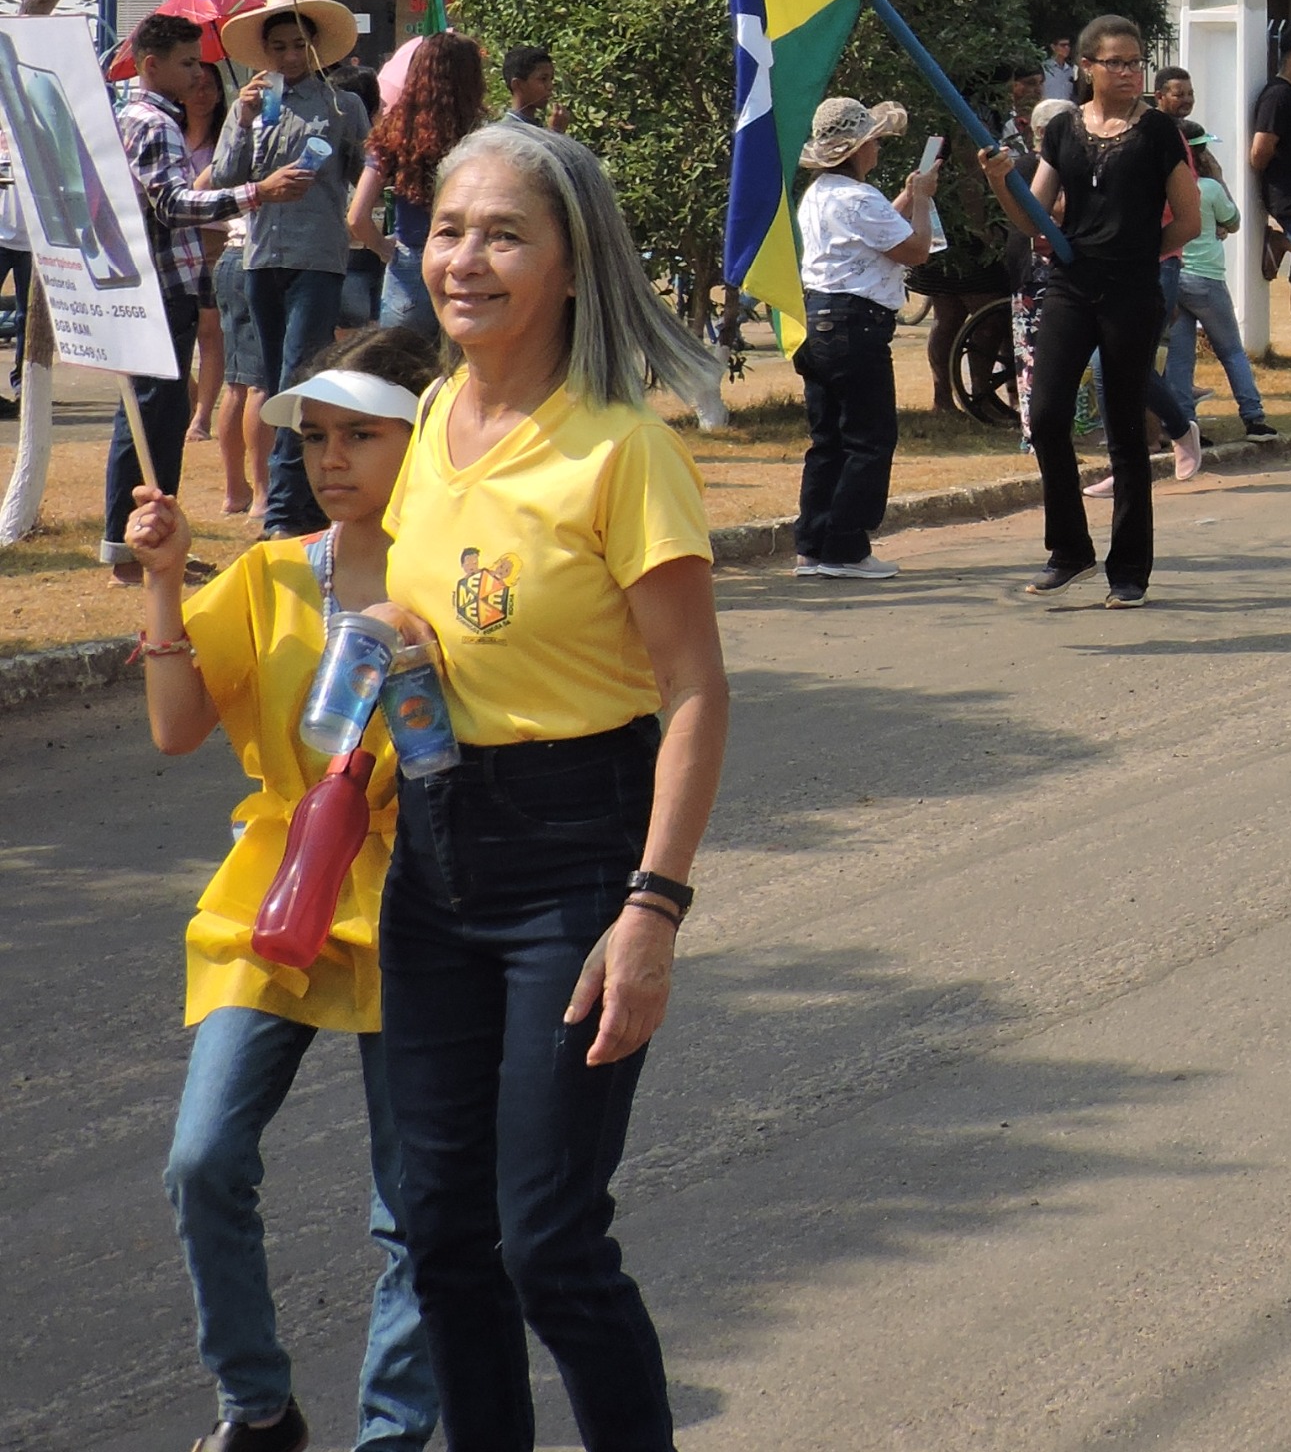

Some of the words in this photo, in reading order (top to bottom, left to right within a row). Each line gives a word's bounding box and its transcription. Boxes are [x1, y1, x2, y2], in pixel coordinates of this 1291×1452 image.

[43, 274, 77, 291] Motorola
[90, 304, 103, 317] 5G
[112, 305, 147, 319] 256GB
[72, 322, 92, 337] RAM
